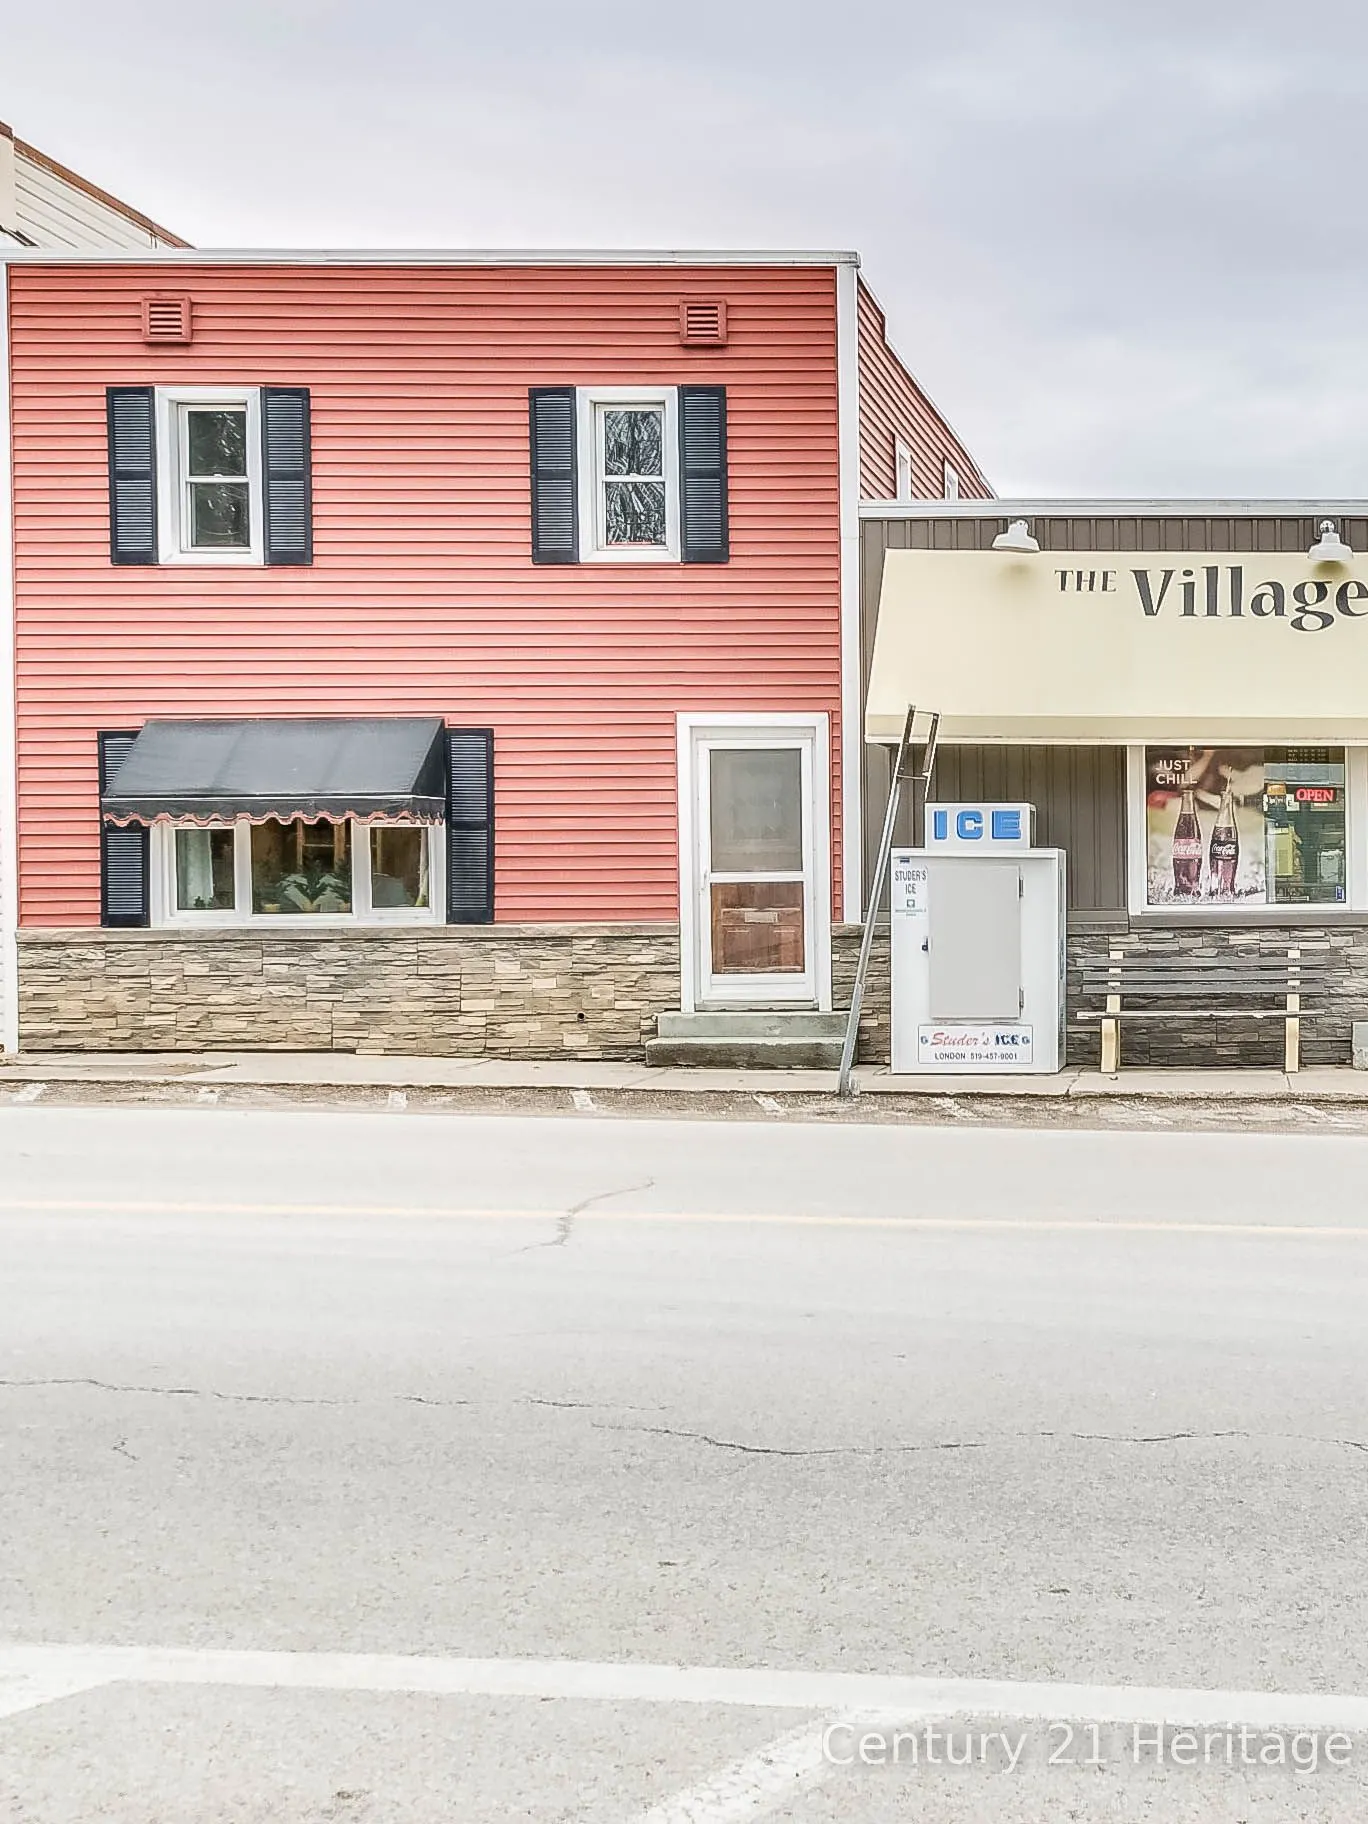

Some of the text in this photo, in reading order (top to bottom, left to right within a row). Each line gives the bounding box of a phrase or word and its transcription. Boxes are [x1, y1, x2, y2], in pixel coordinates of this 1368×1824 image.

[1055, 570, 1116, 592] THE
[1155, 759, 1191, 771] JUST
[1155, 774, 1198, 785] CHILL
[1296, 788, 1334, 802] OPEN
[934, 810, 1022, 840] ICE
[894, 869, 927, 881] STUDER'S
[905, 884, 917, 894] ICE
[930, 1031, 1020, 1046] Studer's ICE
[934, 1052, 966, 1060] LONDON
